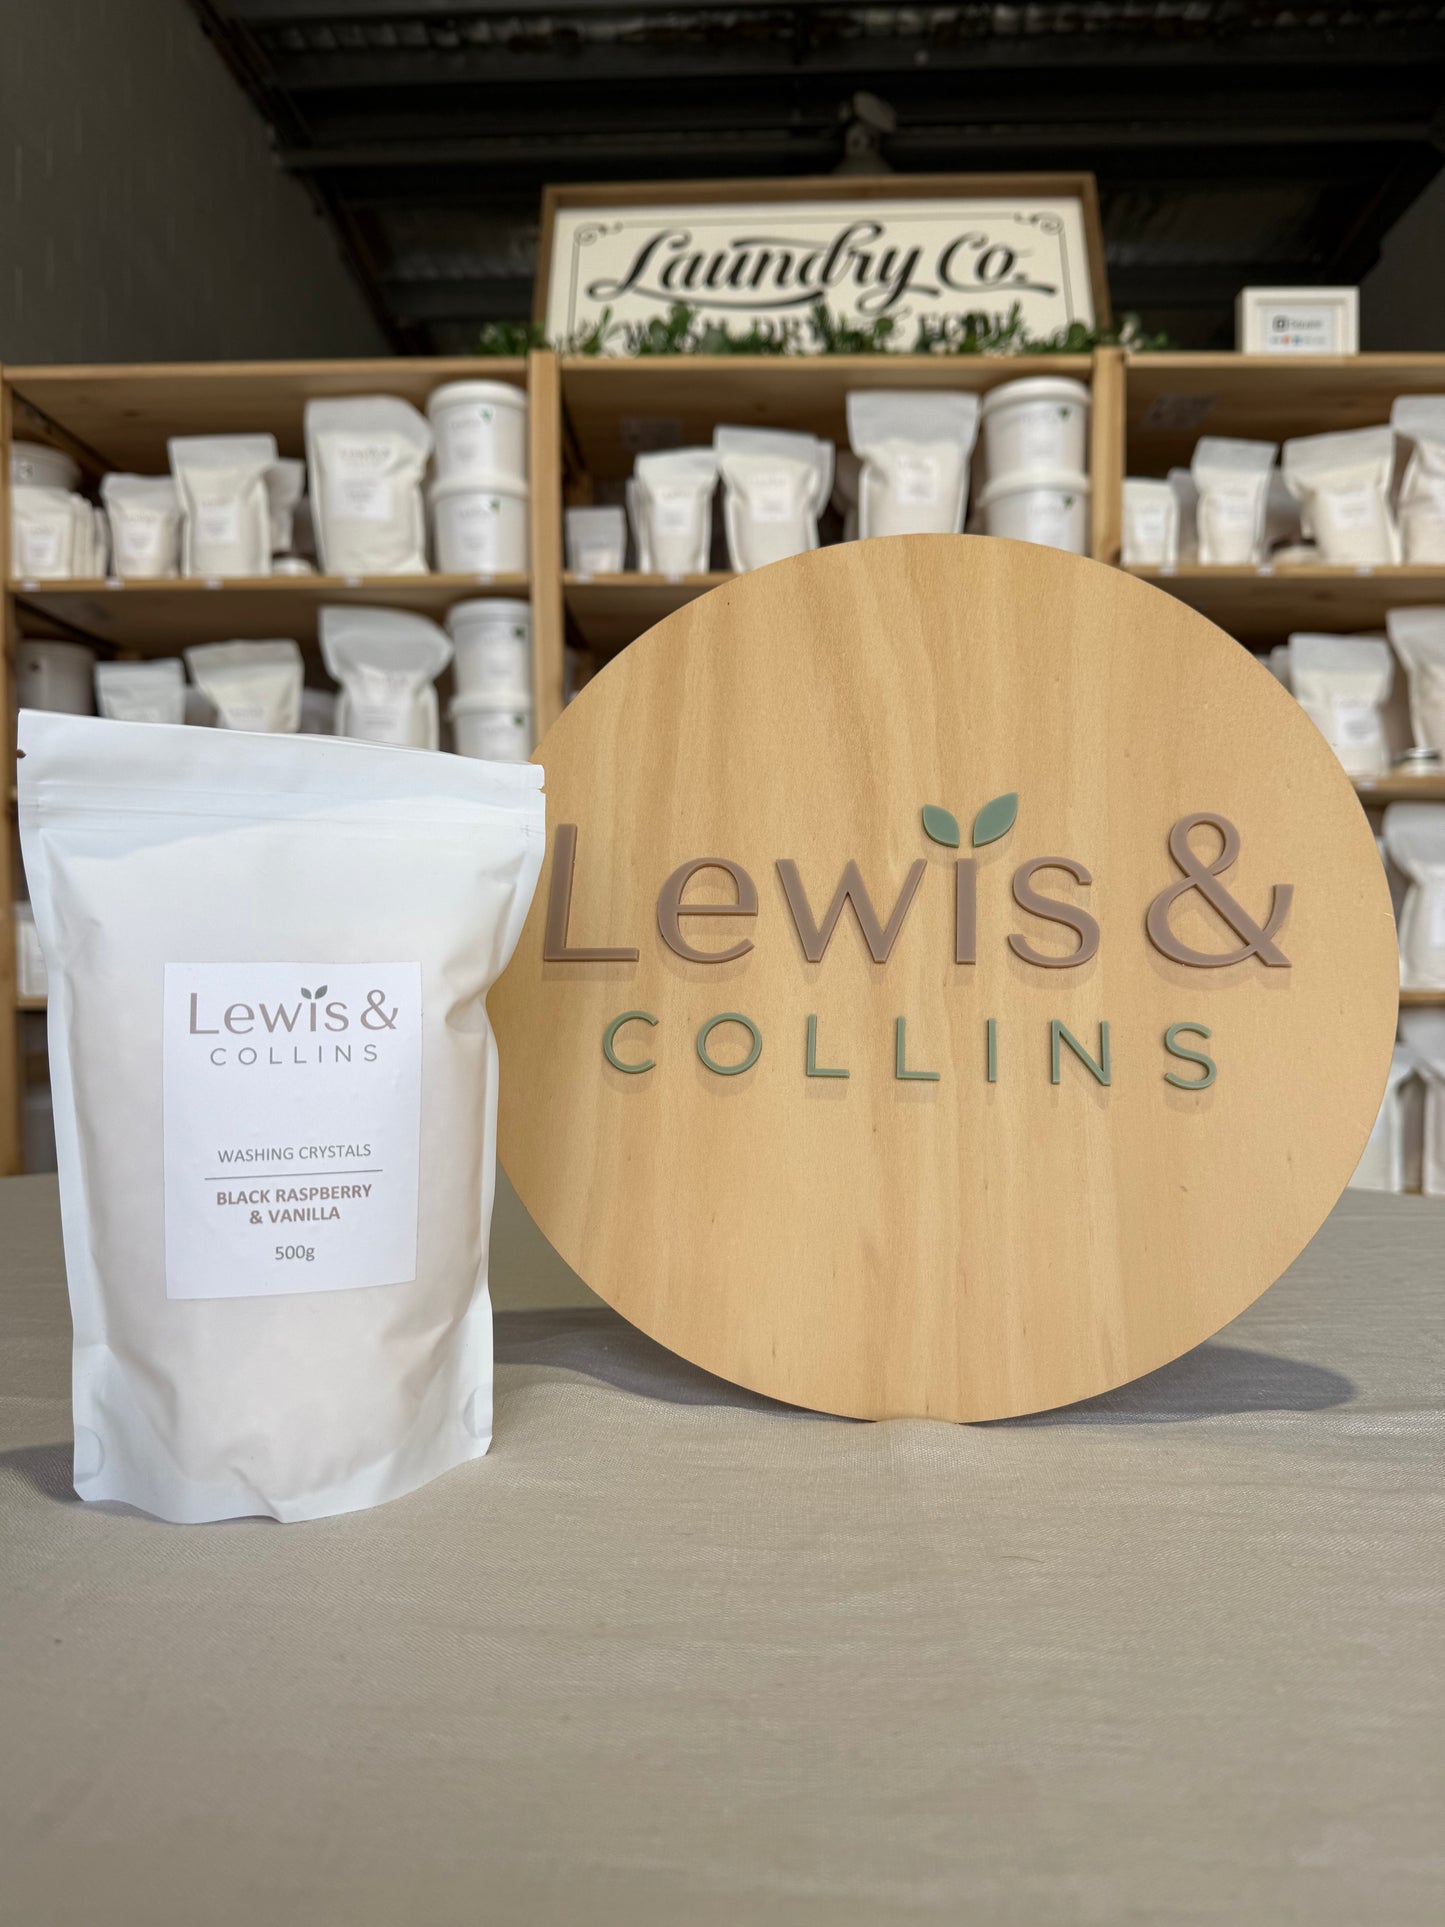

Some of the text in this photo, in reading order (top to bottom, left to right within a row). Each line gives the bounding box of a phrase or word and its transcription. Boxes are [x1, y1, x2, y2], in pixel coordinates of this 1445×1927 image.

[585, 220, 1058, 315] Laundry Co.
[543, 793, 1294, 969] Lewis &
[189, 985, 399, 1034] Lewis &
[210, 1043, 378, 1066] COLLINS
[603, 1010, 1217, 1091] COLLINS
[218, 1143, 372, 1163] WASHING CRYSTALS
[216, 1184, 373, 1206] BLACK RASPBERRY
[249, 1206, 340, 1224] & VANILLA
[274, 1245, 315, 1261] 500g
